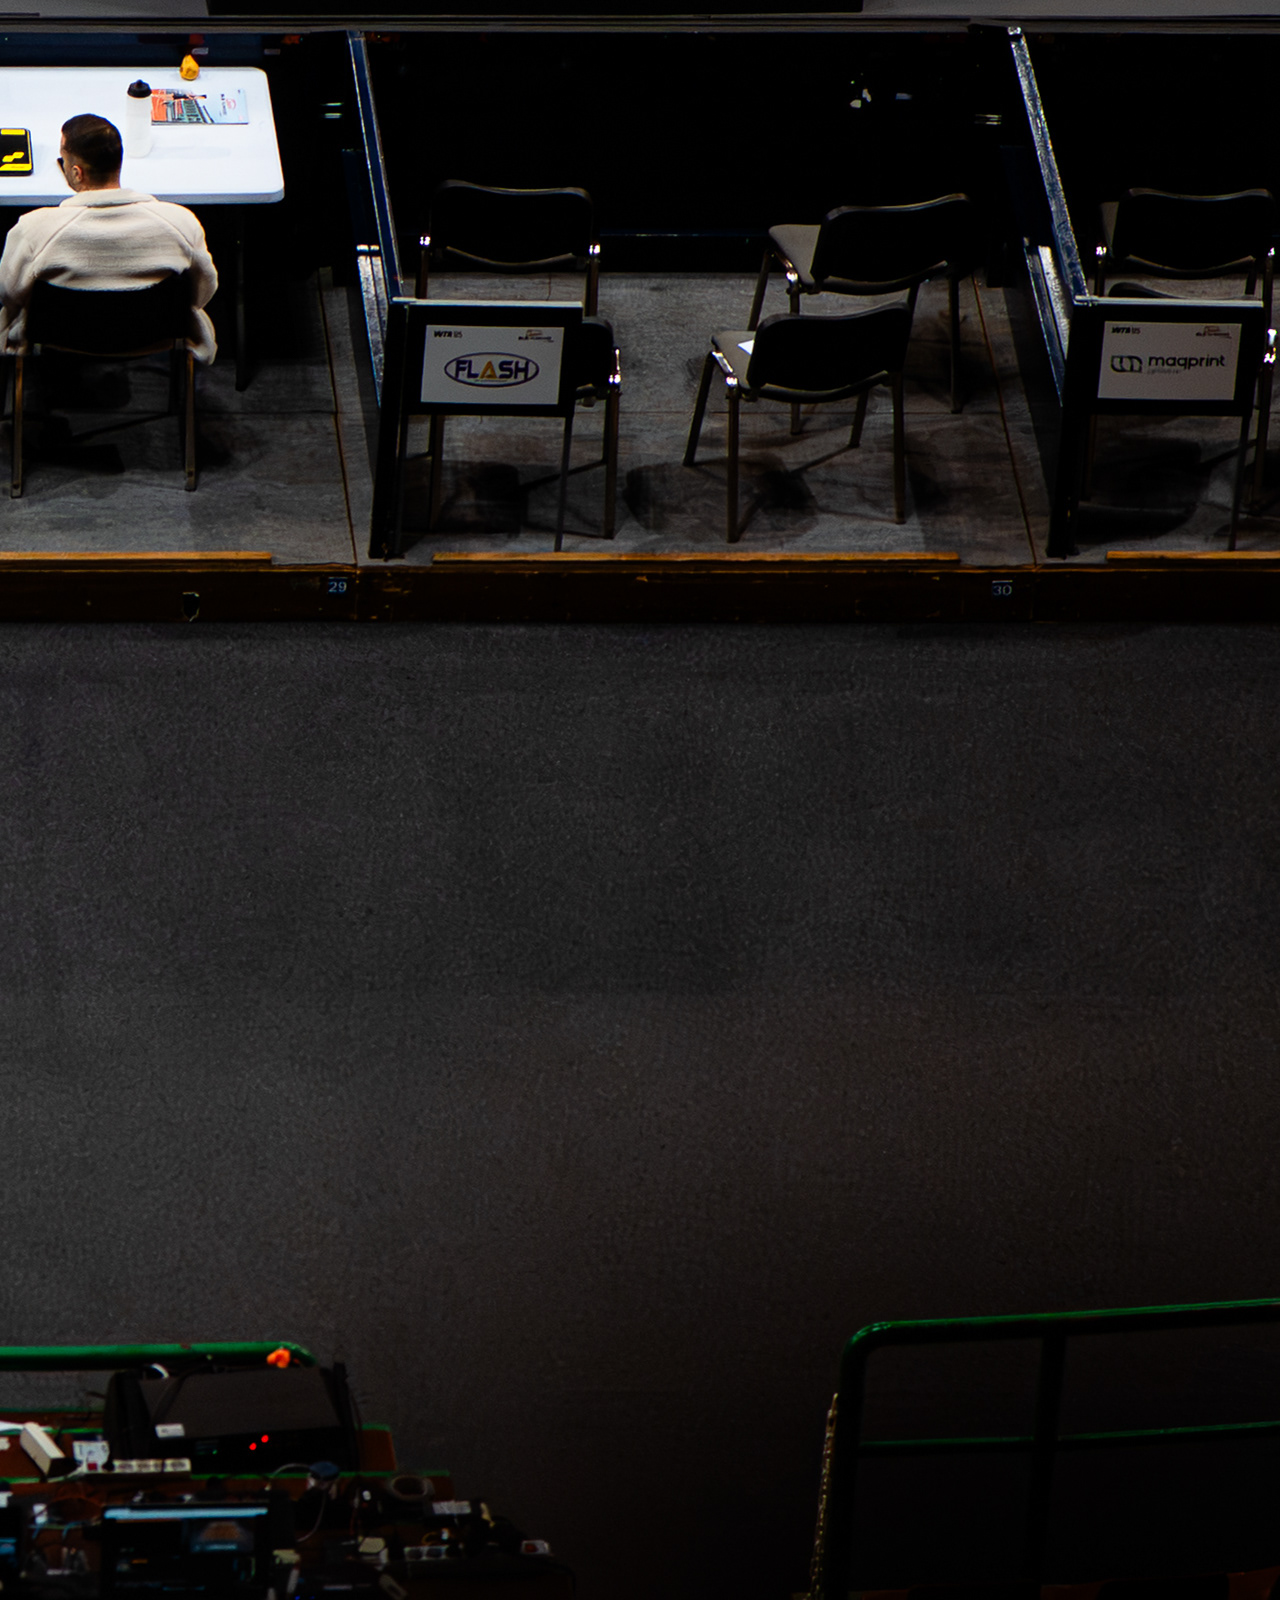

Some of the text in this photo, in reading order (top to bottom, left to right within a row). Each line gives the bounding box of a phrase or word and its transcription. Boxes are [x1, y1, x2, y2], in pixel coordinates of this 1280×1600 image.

[455, 359, 529, 379] FLASH
[1148, 354, 1225, 370] maqprint
[328, 581, 347, 592] 29
[992, 584, 1013, 596] 30
